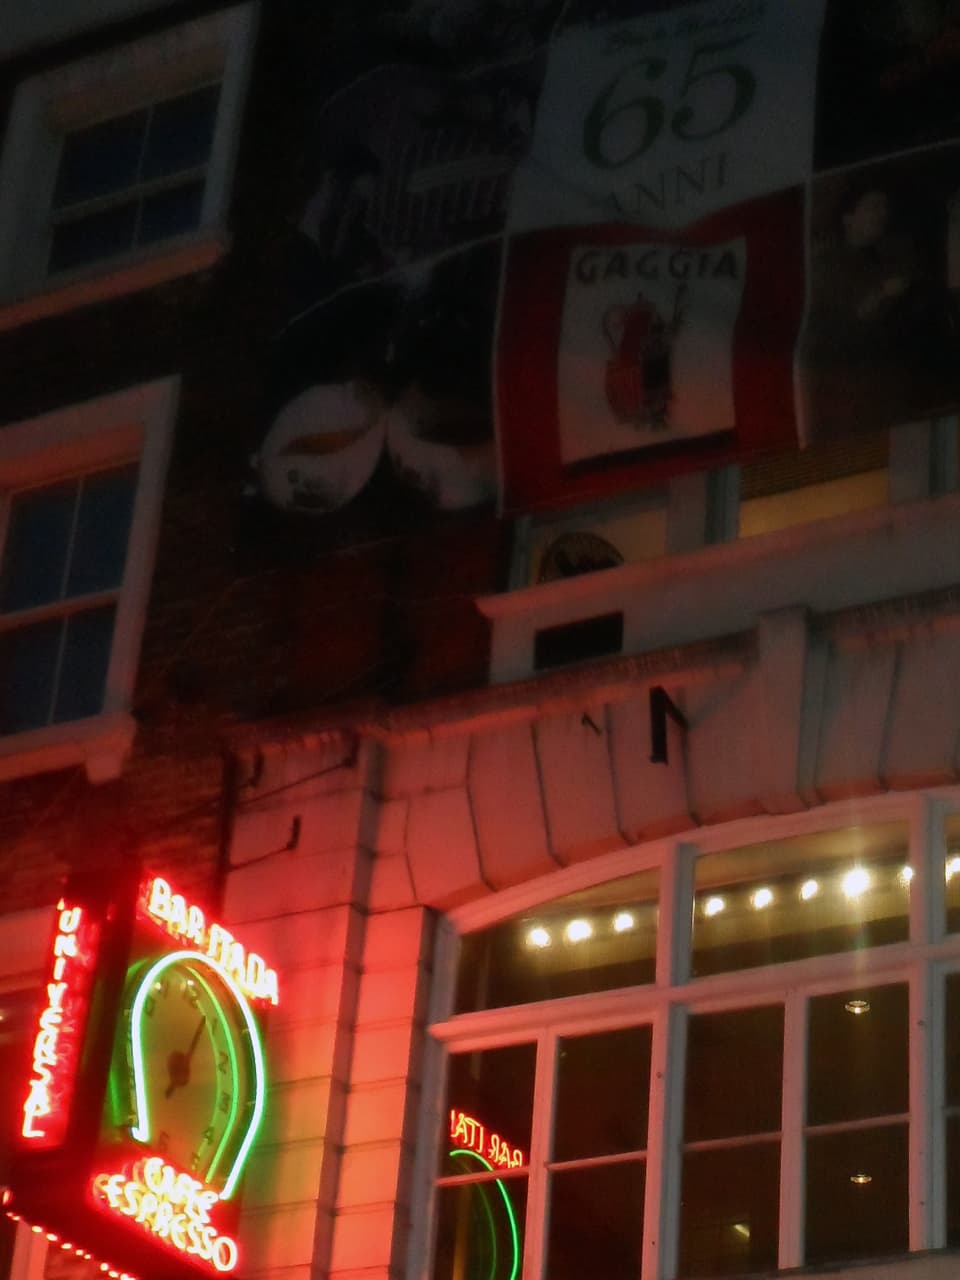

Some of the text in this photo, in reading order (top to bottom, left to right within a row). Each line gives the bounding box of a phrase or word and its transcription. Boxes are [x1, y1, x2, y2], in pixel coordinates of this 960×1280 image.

[583, 33, 758, 170] 65
[574, 248, 738, 284] GAGGIA
[148, 877, 206, 946] BAR
[22, 906, 81, 1138] UNIVERSAL
[102, 1174, 238, 1272] ESPRESSO
